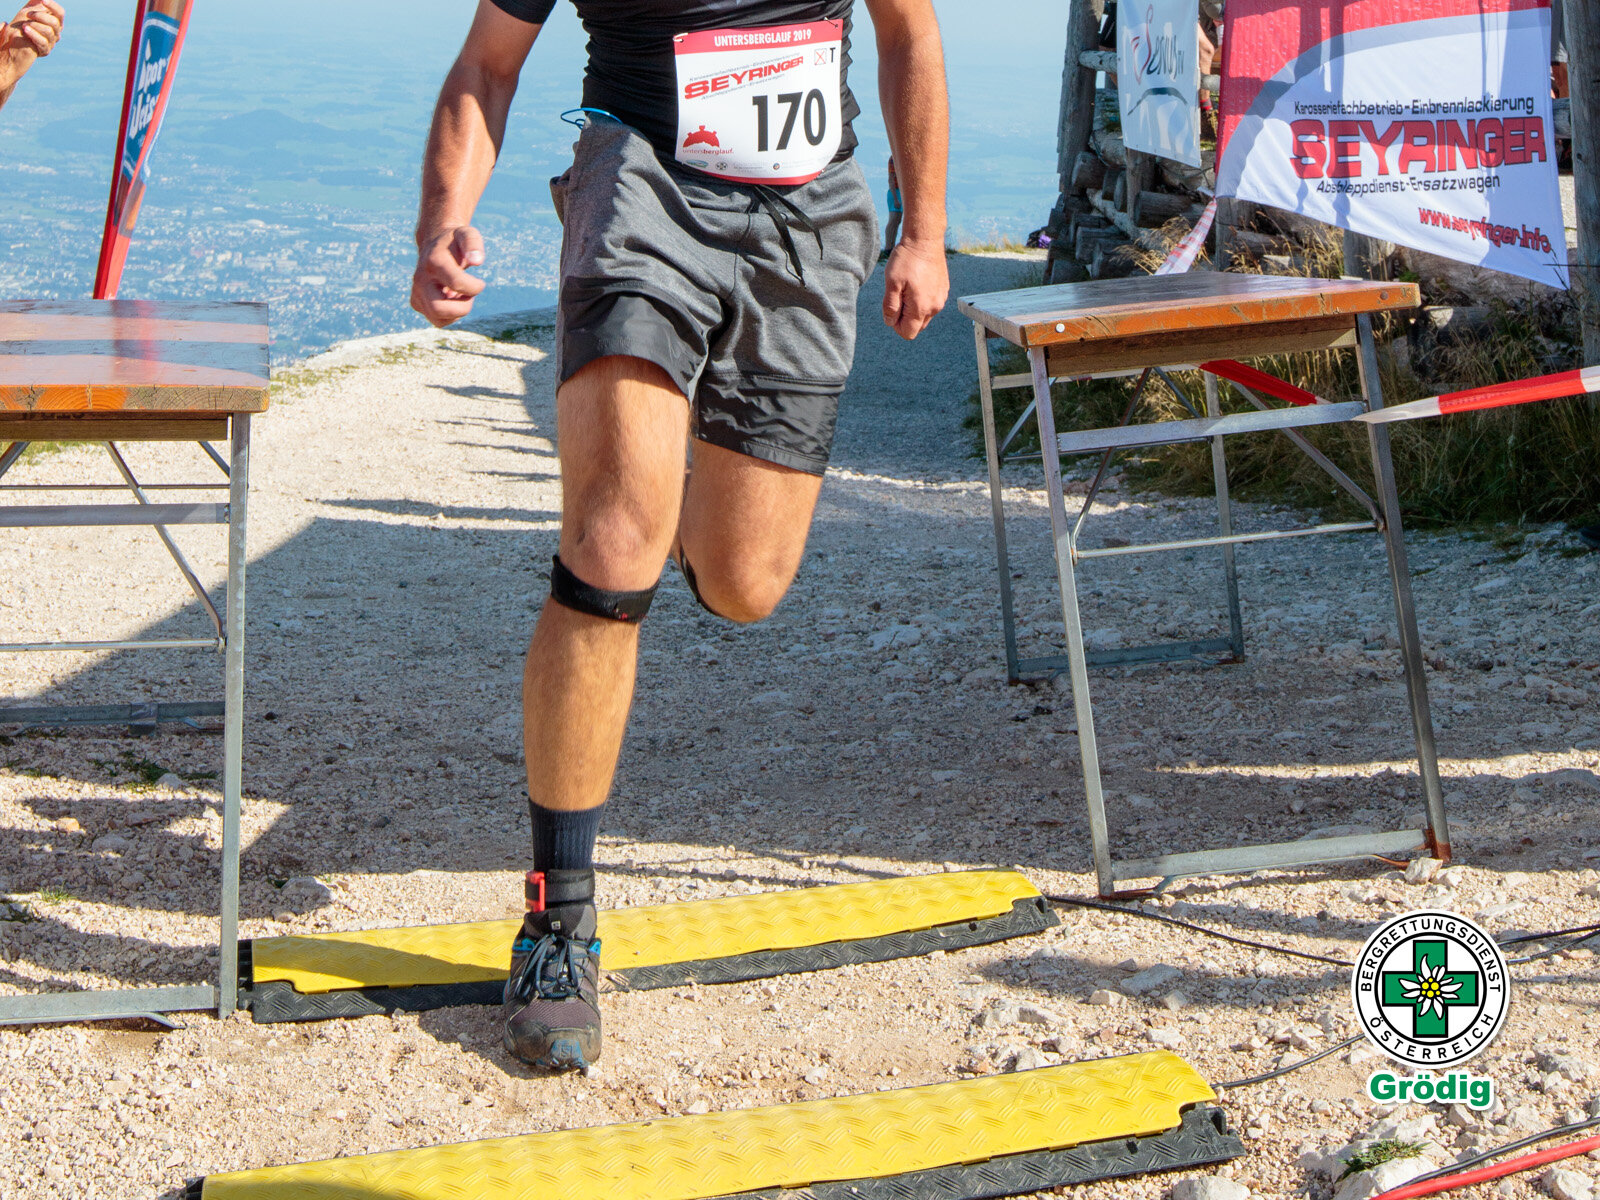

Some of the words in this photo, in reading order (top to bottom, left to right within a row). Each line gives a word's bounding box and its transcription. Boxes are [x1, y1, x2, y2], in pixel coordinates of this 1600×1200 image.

[714, 31, 791, 47] UNTERSBERGLAUF
[793, 29, 812, 42] 2019
[684, 56, 803, 100] SEYRINGER
[752, 88, 826, 153] 170
[1289, 116, 1548, 179] SEYRINGER
[1418, 207, 1552, 254] www.seyringer.info
